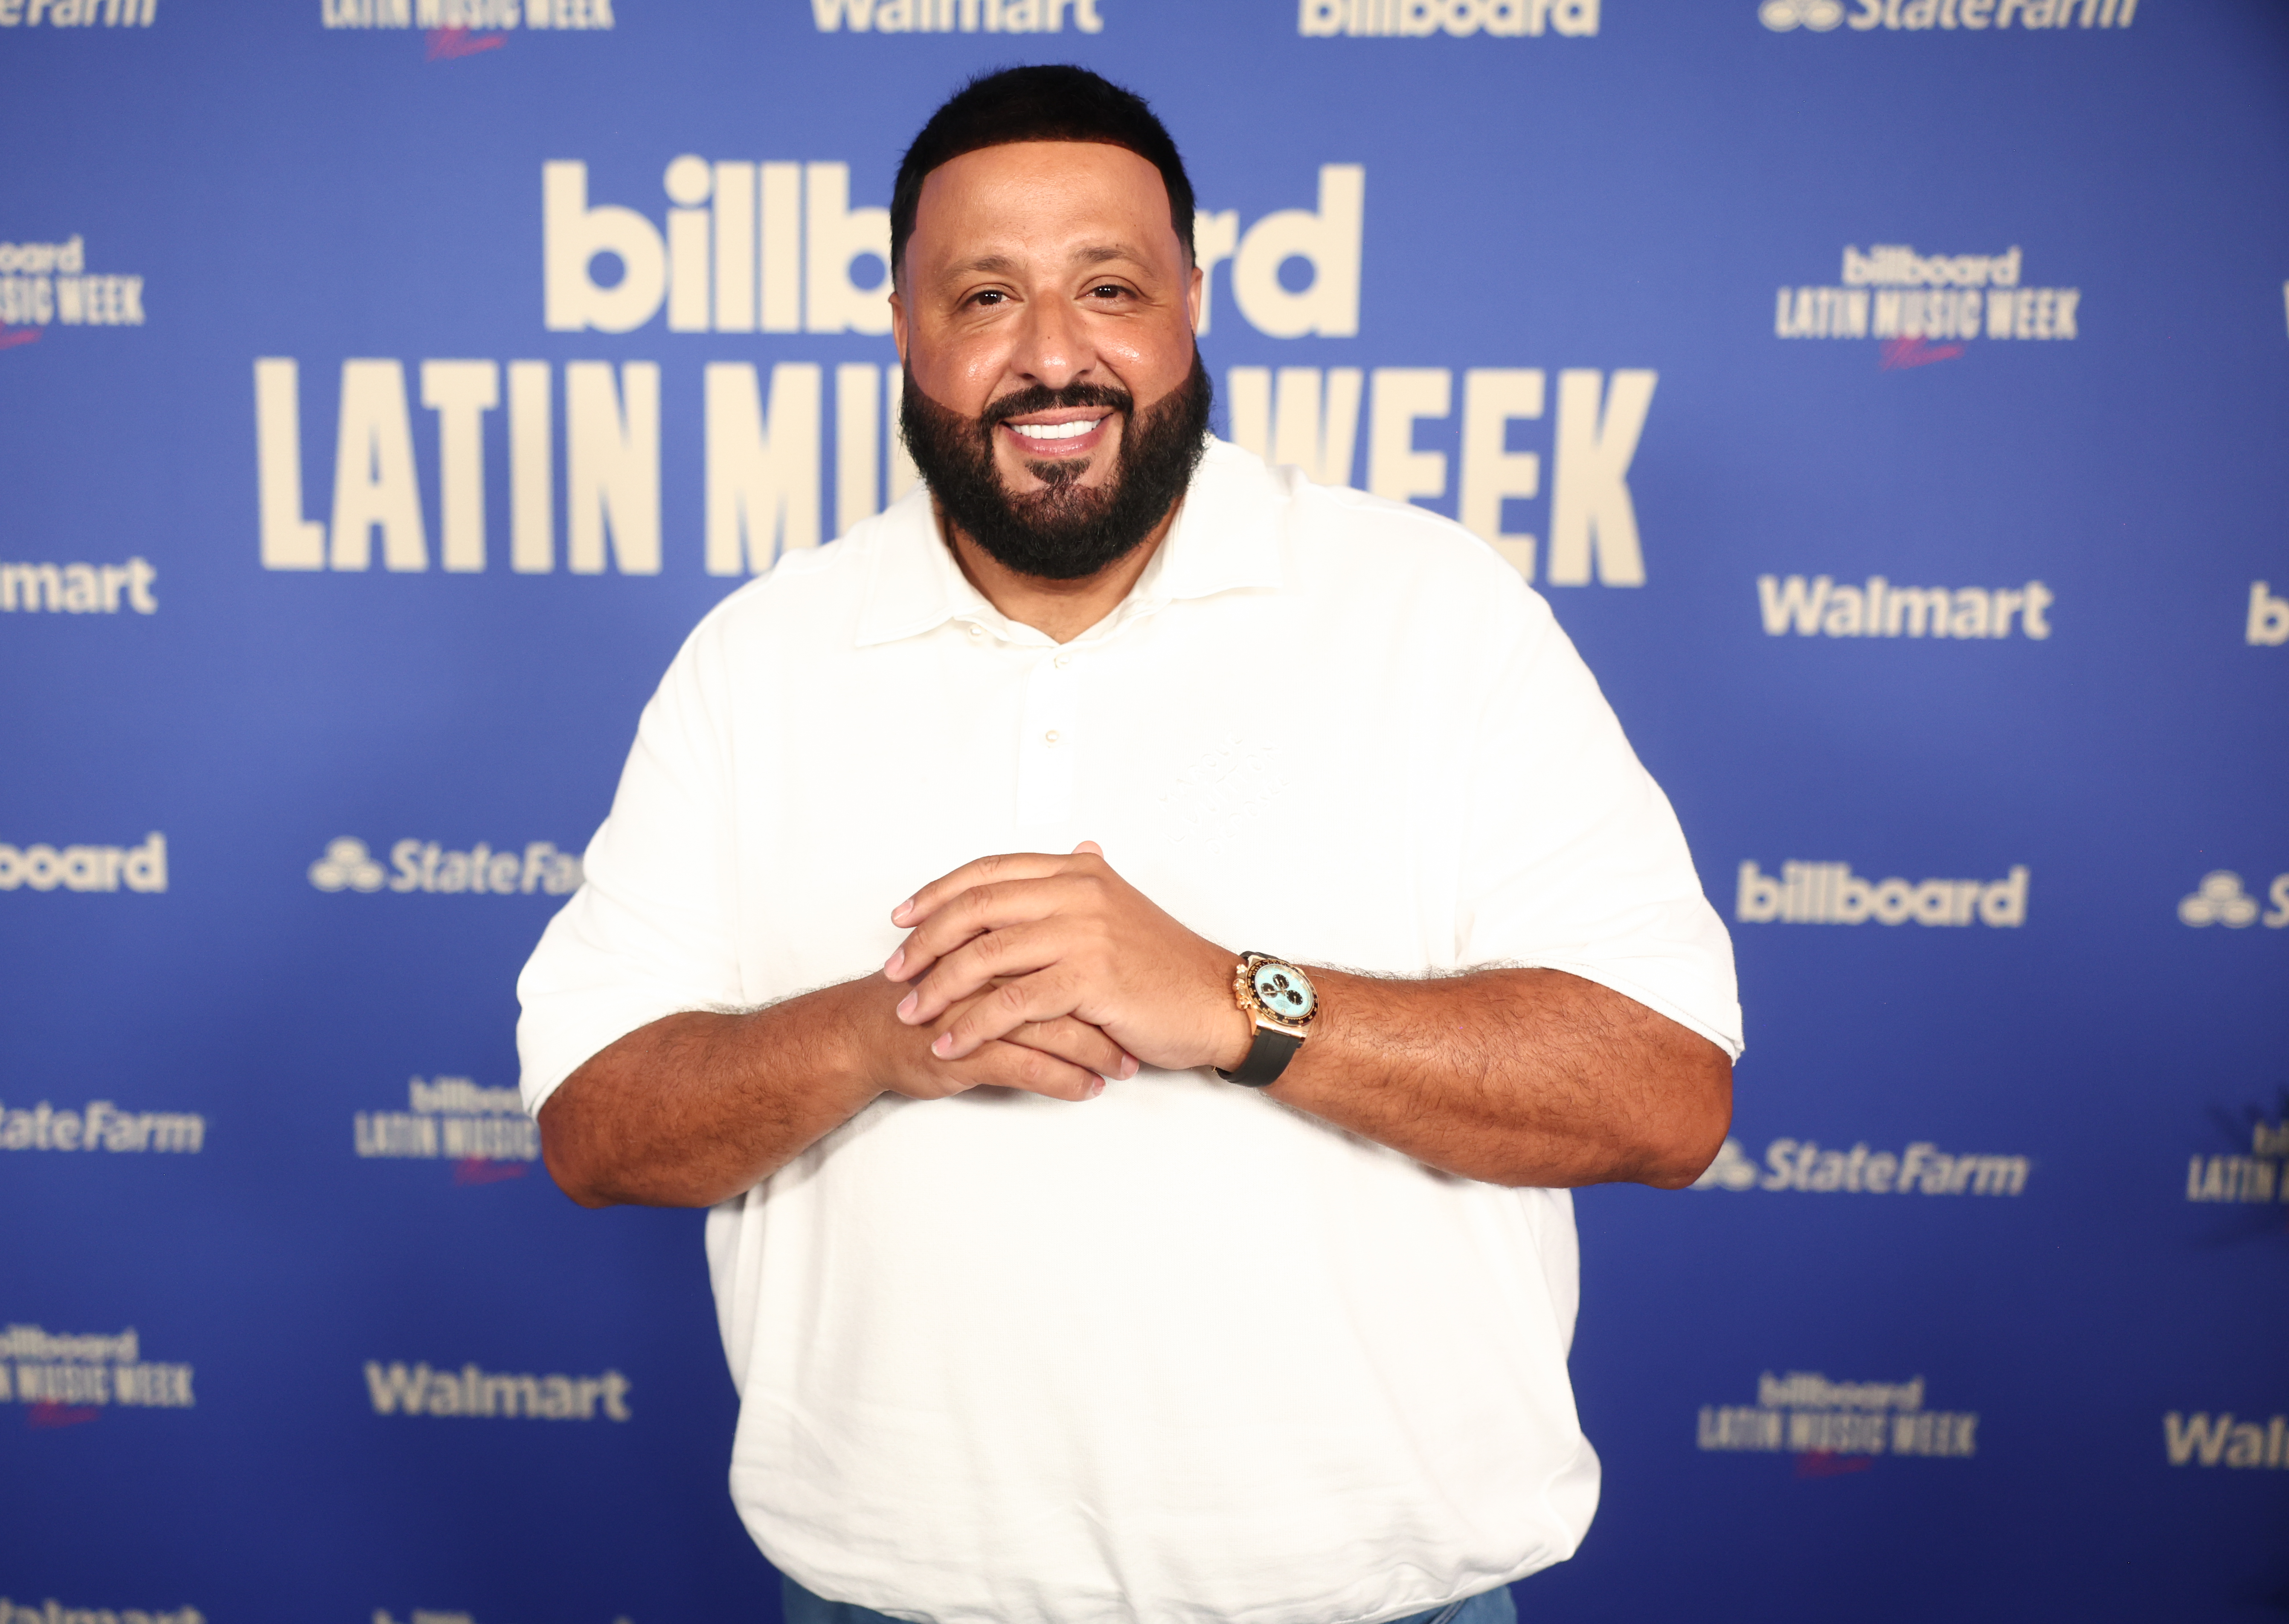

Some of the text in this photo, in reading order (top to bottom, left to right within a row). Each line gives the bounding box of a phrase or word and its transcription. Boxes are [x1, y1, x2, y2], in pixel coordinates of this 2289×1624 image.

[542, 154, 1365, 339] billbrd
[1842, 244, 2023, 287] billboard
[57, 274, 146, 326] WEEK
[1775, 287, 2080, 340] LATIN MUSIC WEEK
[254, 357, 662, 575] LATIN
[1227, 367, 1659, 588] WEEK
[1757, 574, 2054, 640] Walmart
[1735, 860, 2030, 927] billboard
[0, 1099, 206, 1153] ateFarm
[1760, 1137, 2030, 1198] StateFarm
[0, 1322, 139, 1362] illboard
[364, 1360, 630, 1421] Walmart
